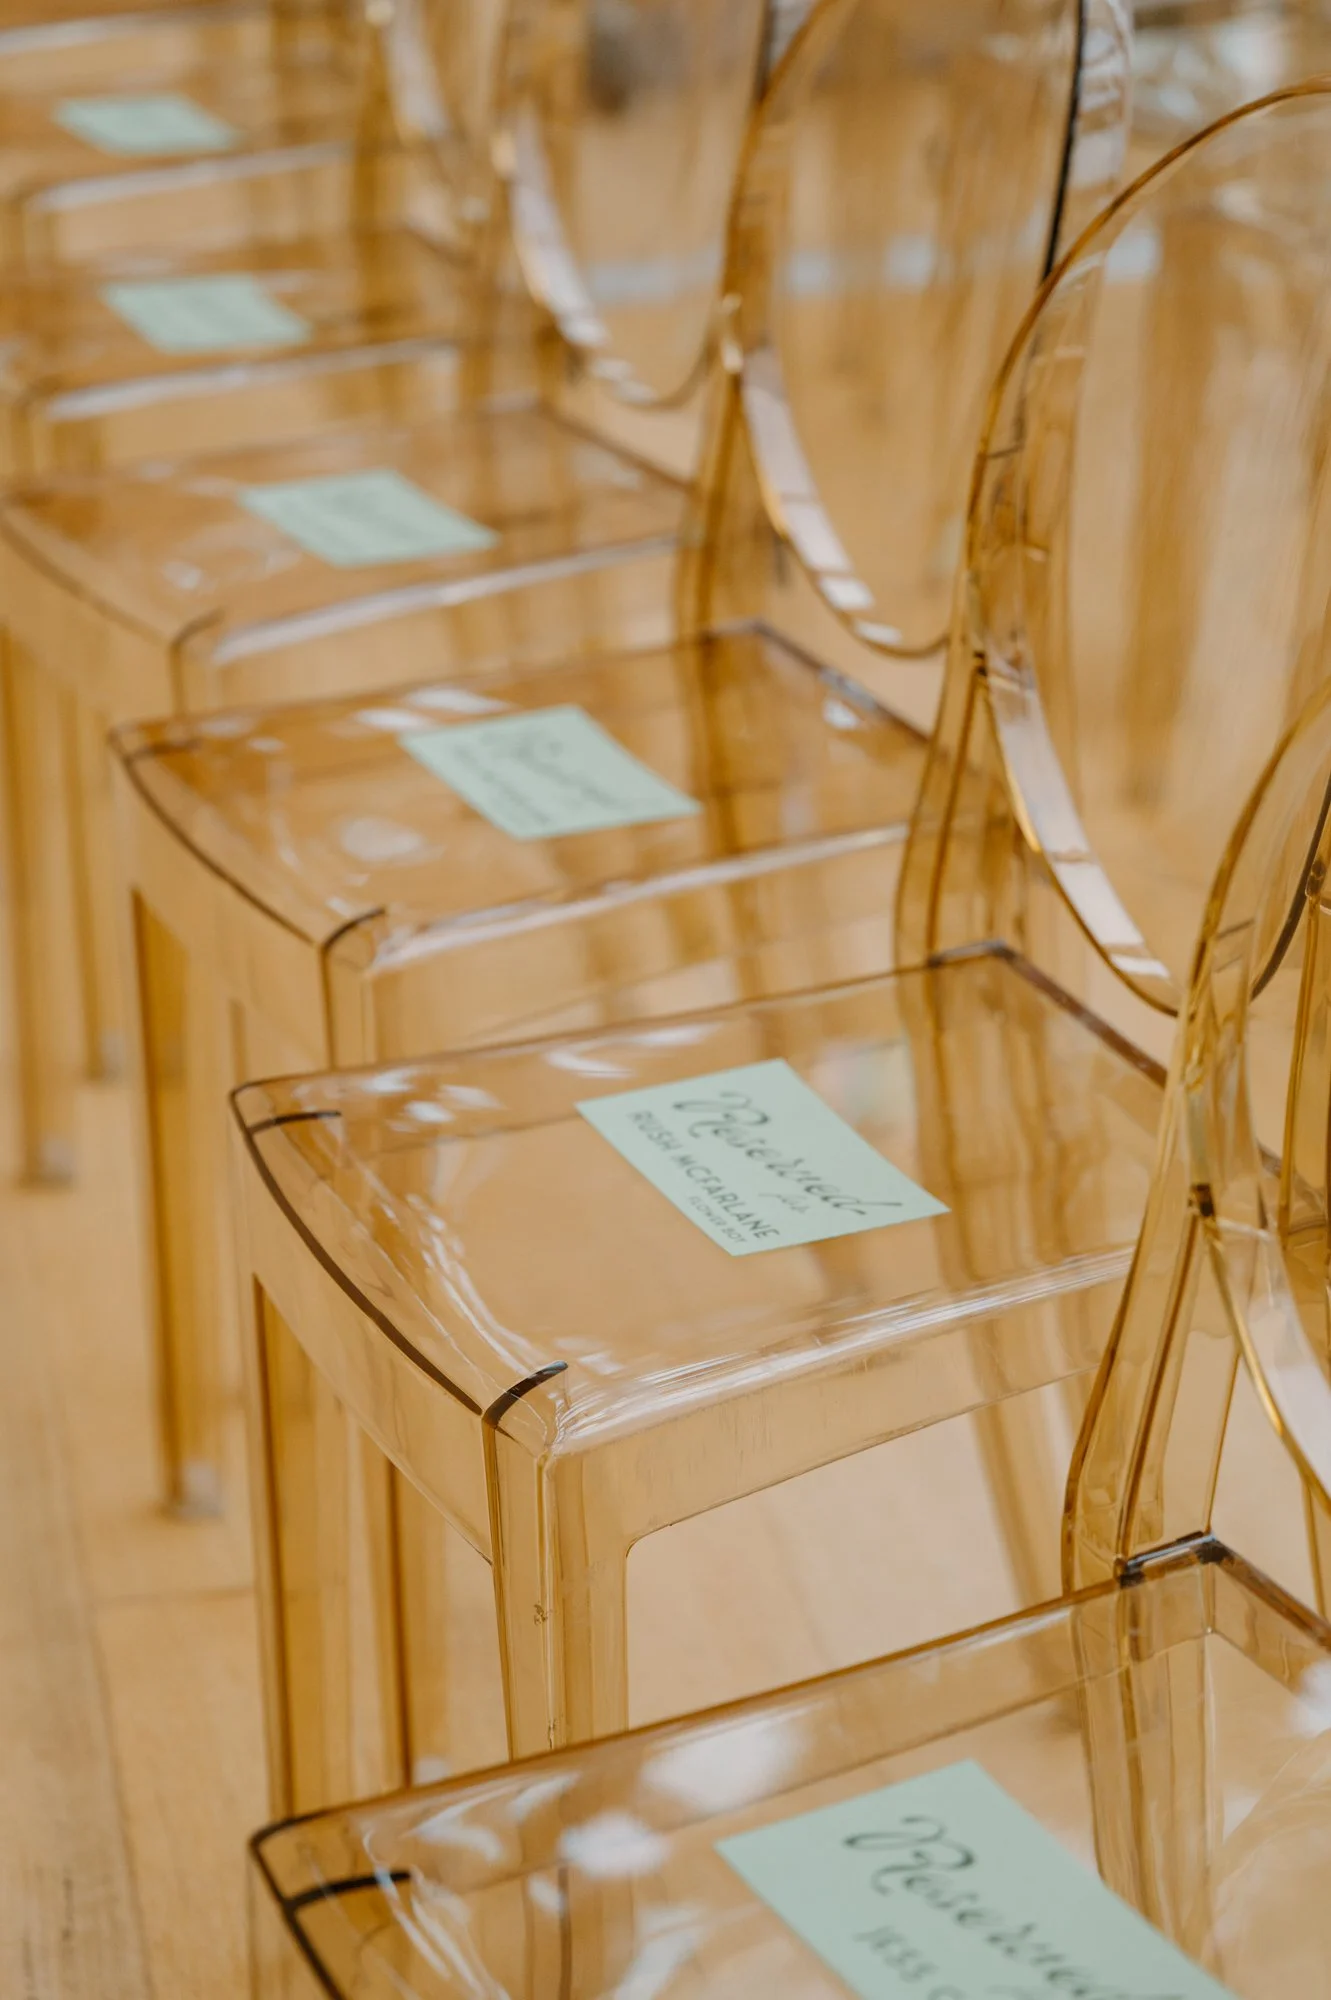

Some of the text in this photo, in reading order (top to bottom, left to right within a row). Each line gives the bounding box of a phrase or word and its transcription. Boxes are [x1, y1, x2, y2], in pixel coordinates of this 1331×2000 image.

[627, 1110, 780, 1239] RUSH MCFARLANE
[672, 1089, 904, 1217] Reserved
